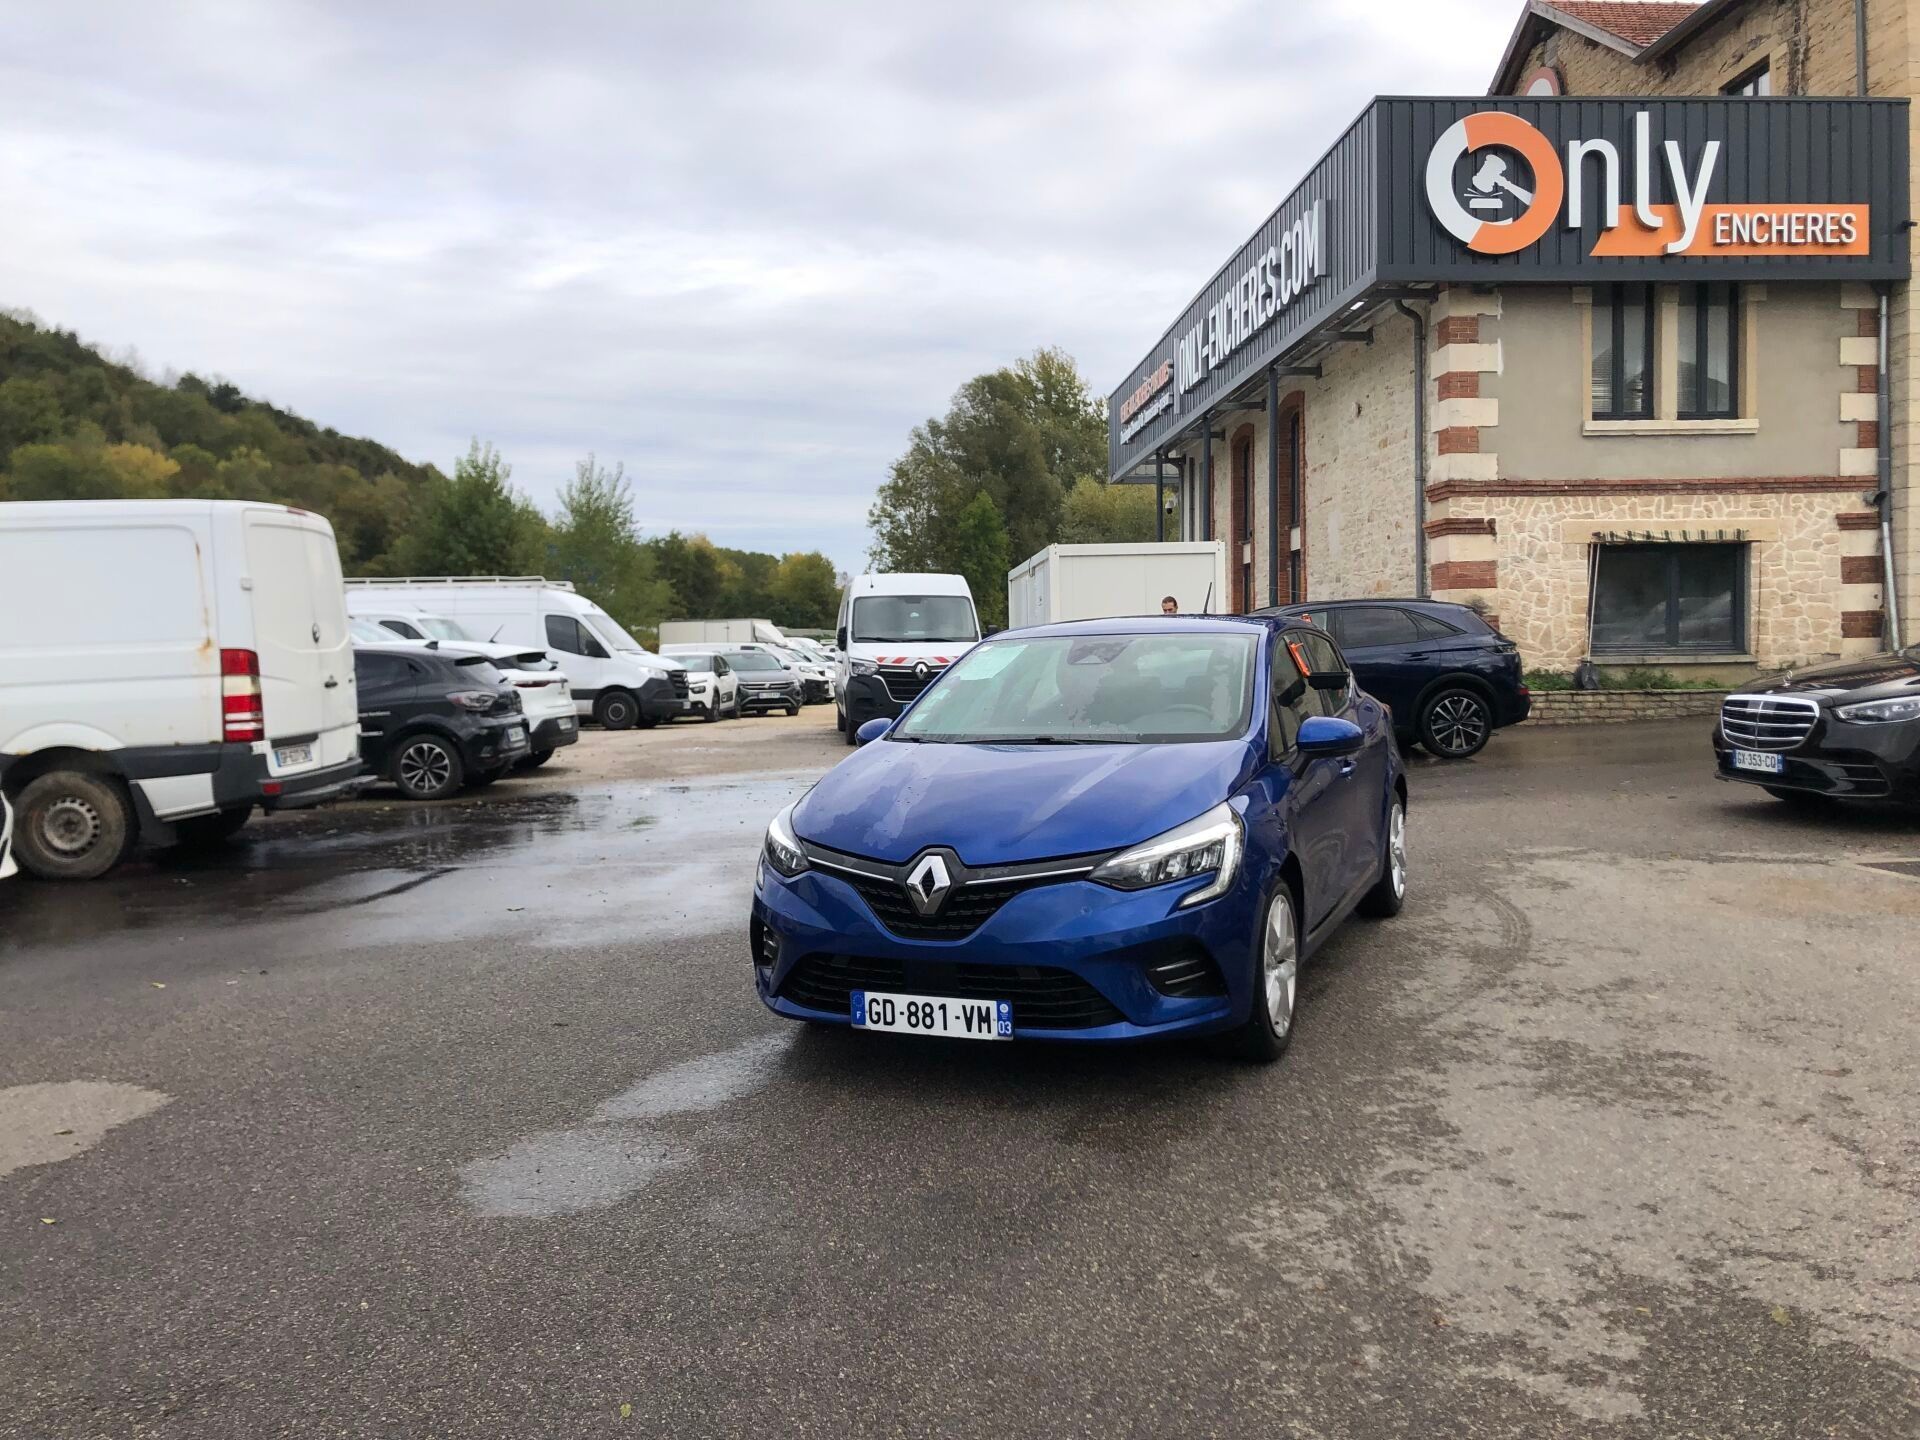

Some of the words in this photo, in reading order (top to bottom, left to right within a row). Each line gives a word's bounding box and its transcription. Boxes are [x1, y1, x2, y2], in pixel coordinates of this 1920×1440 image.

[1426, 111, 1720, 254] Only
[1715, 212, 1857, 246] ENCHERES
[1178, 199, 1323, 395] ONLY-ENCHERES.COM
[856, 1011, 862, 1020] F
[868, 997, 992, 1034] GD-881-VM
[998, 1020, 1011, 1034] 03
